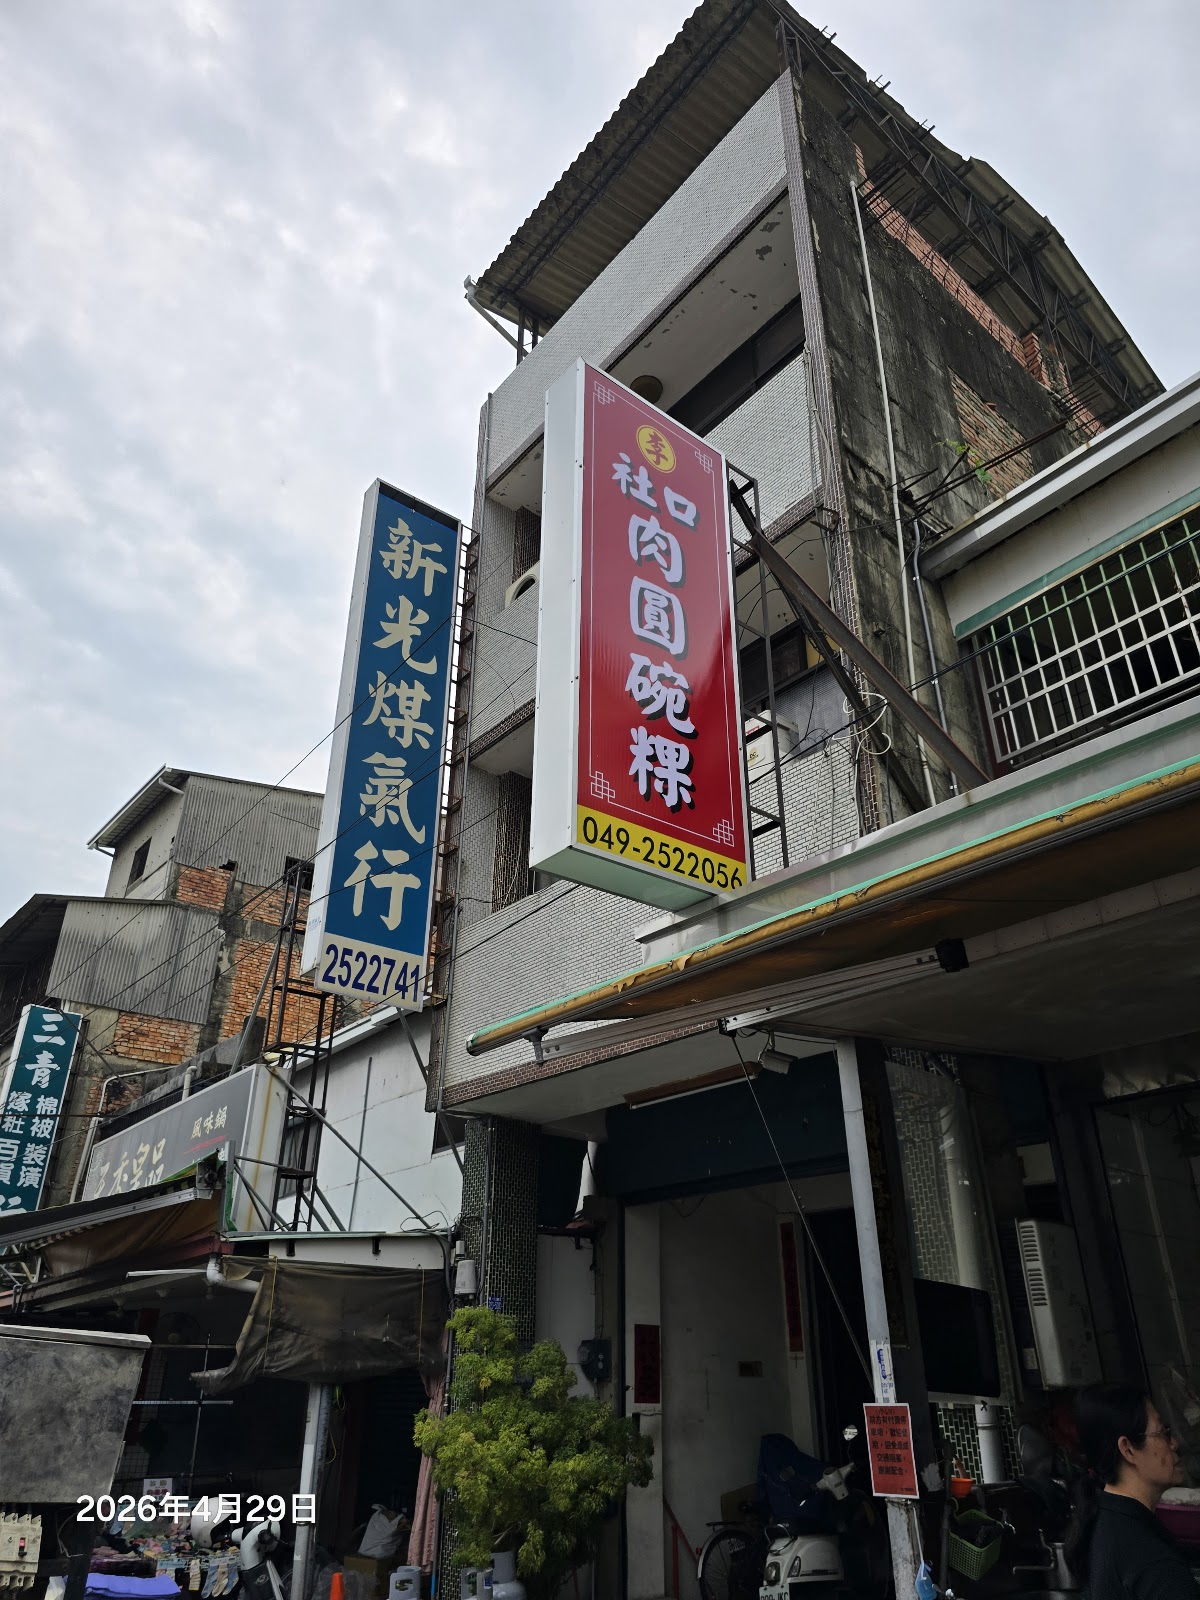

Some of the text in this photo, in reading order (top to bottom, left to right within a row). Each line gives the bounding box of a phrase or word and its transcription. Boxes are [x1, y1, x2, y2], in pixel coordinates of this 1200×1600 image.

[612, 452, 698, 529] 社口
[624, 514, 697, 811] 肉圓碗粿
[344, 517, 448, 931] 新光煤氣行
[583, 816, 742, 890] 049-2522056
[322, 943, 420, 1003] 2522741
[190, 1105, 228, 1140] 風味鍋
